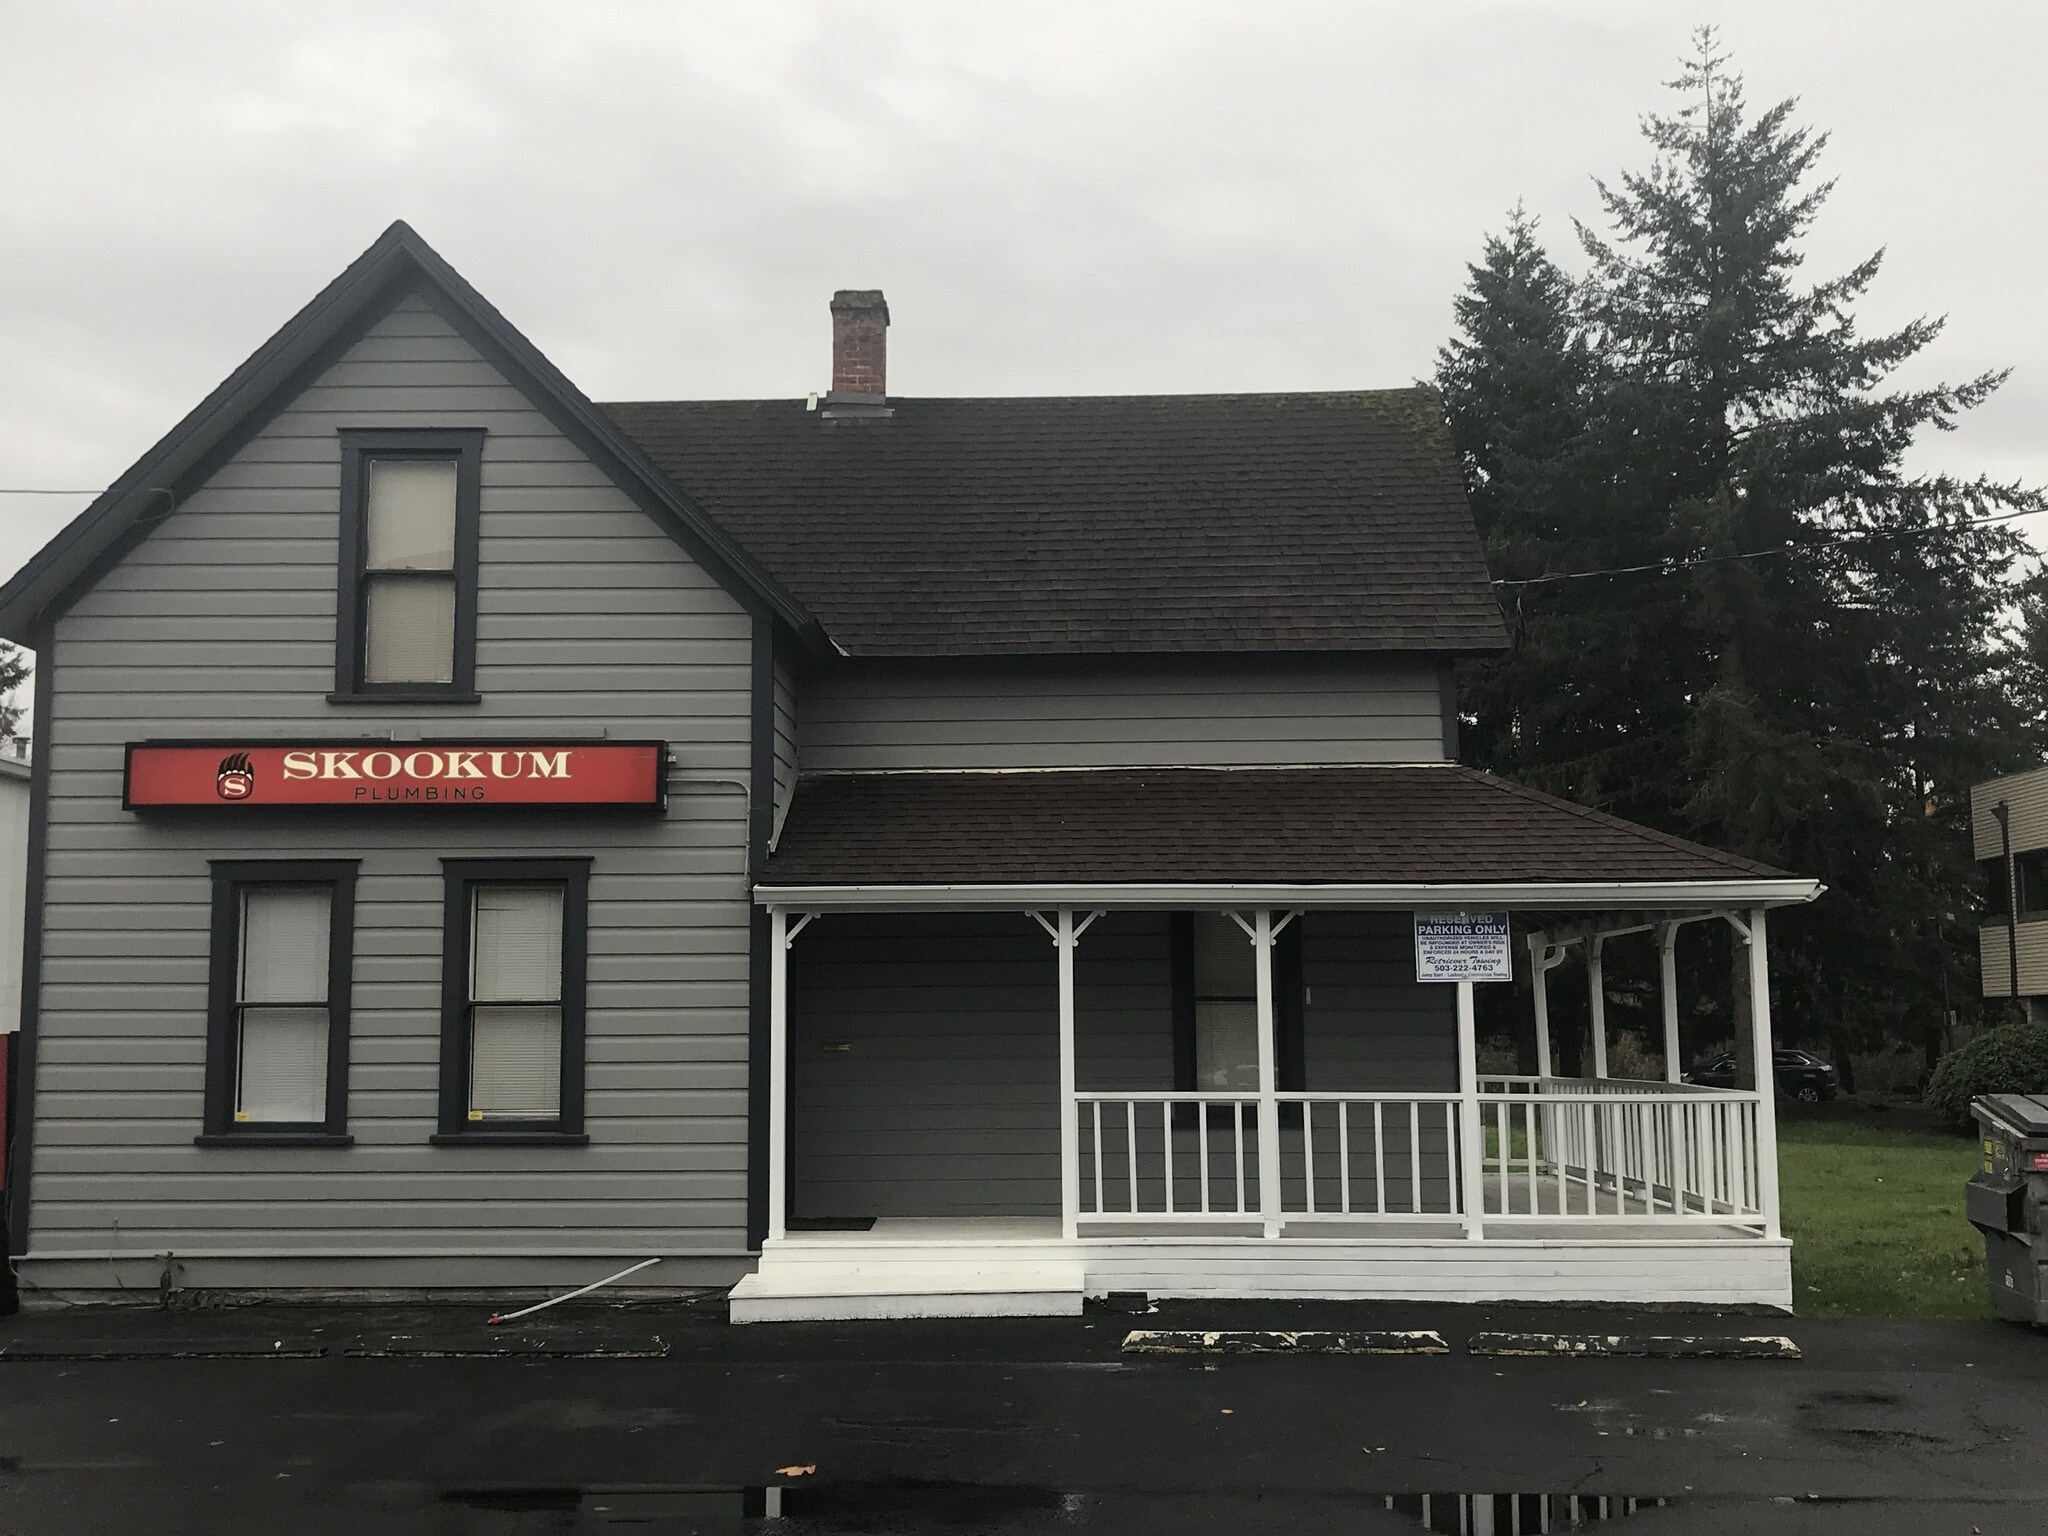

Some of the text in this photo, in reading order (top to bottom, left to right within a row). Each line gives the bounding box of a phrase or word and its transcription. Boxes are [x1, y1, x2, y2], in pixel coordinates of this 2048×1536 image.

[282, 751, 573, 780] SKOOKUM
[224, 777, 246, 795] S
[354, 786, 486, 801] PLUMBING
[1418, 925, 1506, 934] PARKING ONLY
[1425, 956, 1501, 966] Retriever Towing
